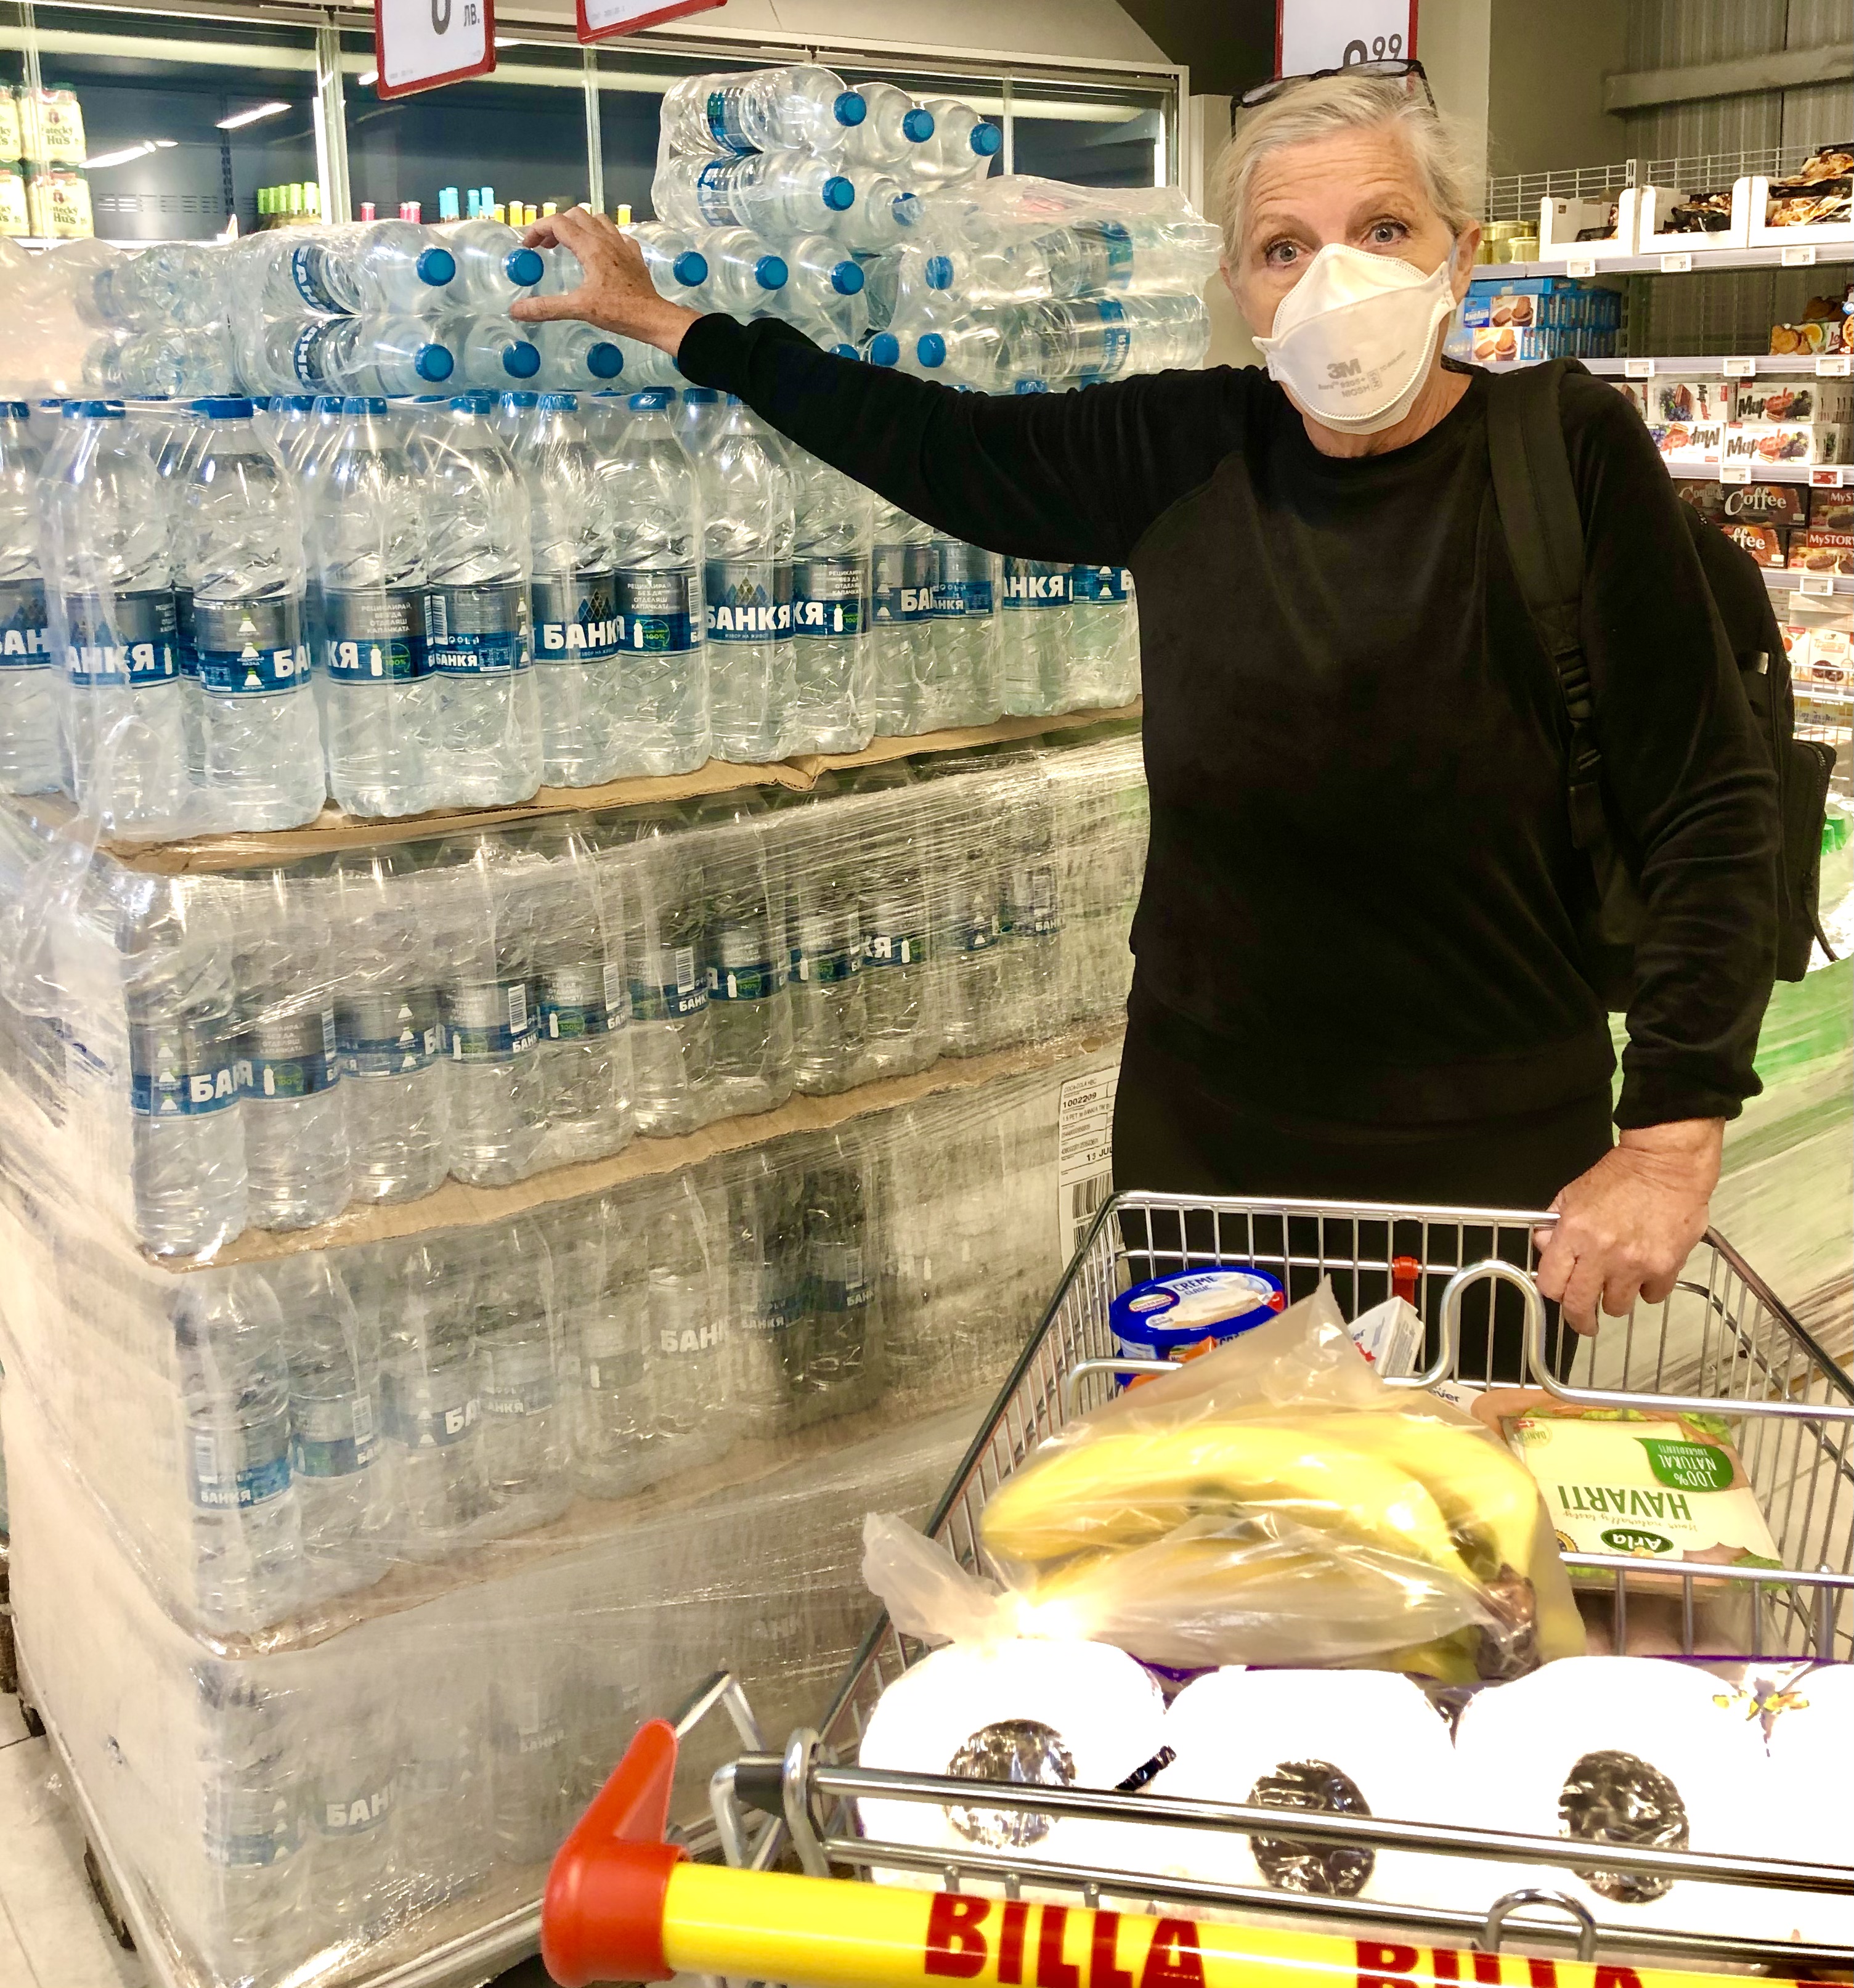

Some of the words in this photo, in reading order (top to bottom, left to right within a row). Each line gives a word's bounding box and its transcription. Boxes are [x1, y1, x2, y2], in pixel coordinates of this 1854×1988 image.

[1327, 358, 1362, 379] 3M
[1725, 487, 1787, 516] Coffee
[1728, 528, 1766, 550] ffee
[705, 603, 791, 631] БАНКЯ
[0, 629, 50, 656] АН
[435, 653, 478, 667] БАНКЯ
[1063, 1092, 1097, 1108] 1002209
[1657, 1454, 1717, 1471] NATURAL
[1673, 1470, 1717, 1488] 100%
[1557, 1485, 1692, 1521] HAVARTI
[1612, 1533, 1662, 1550] Arla
[924, 1892, 1206, 1988] BILLA
